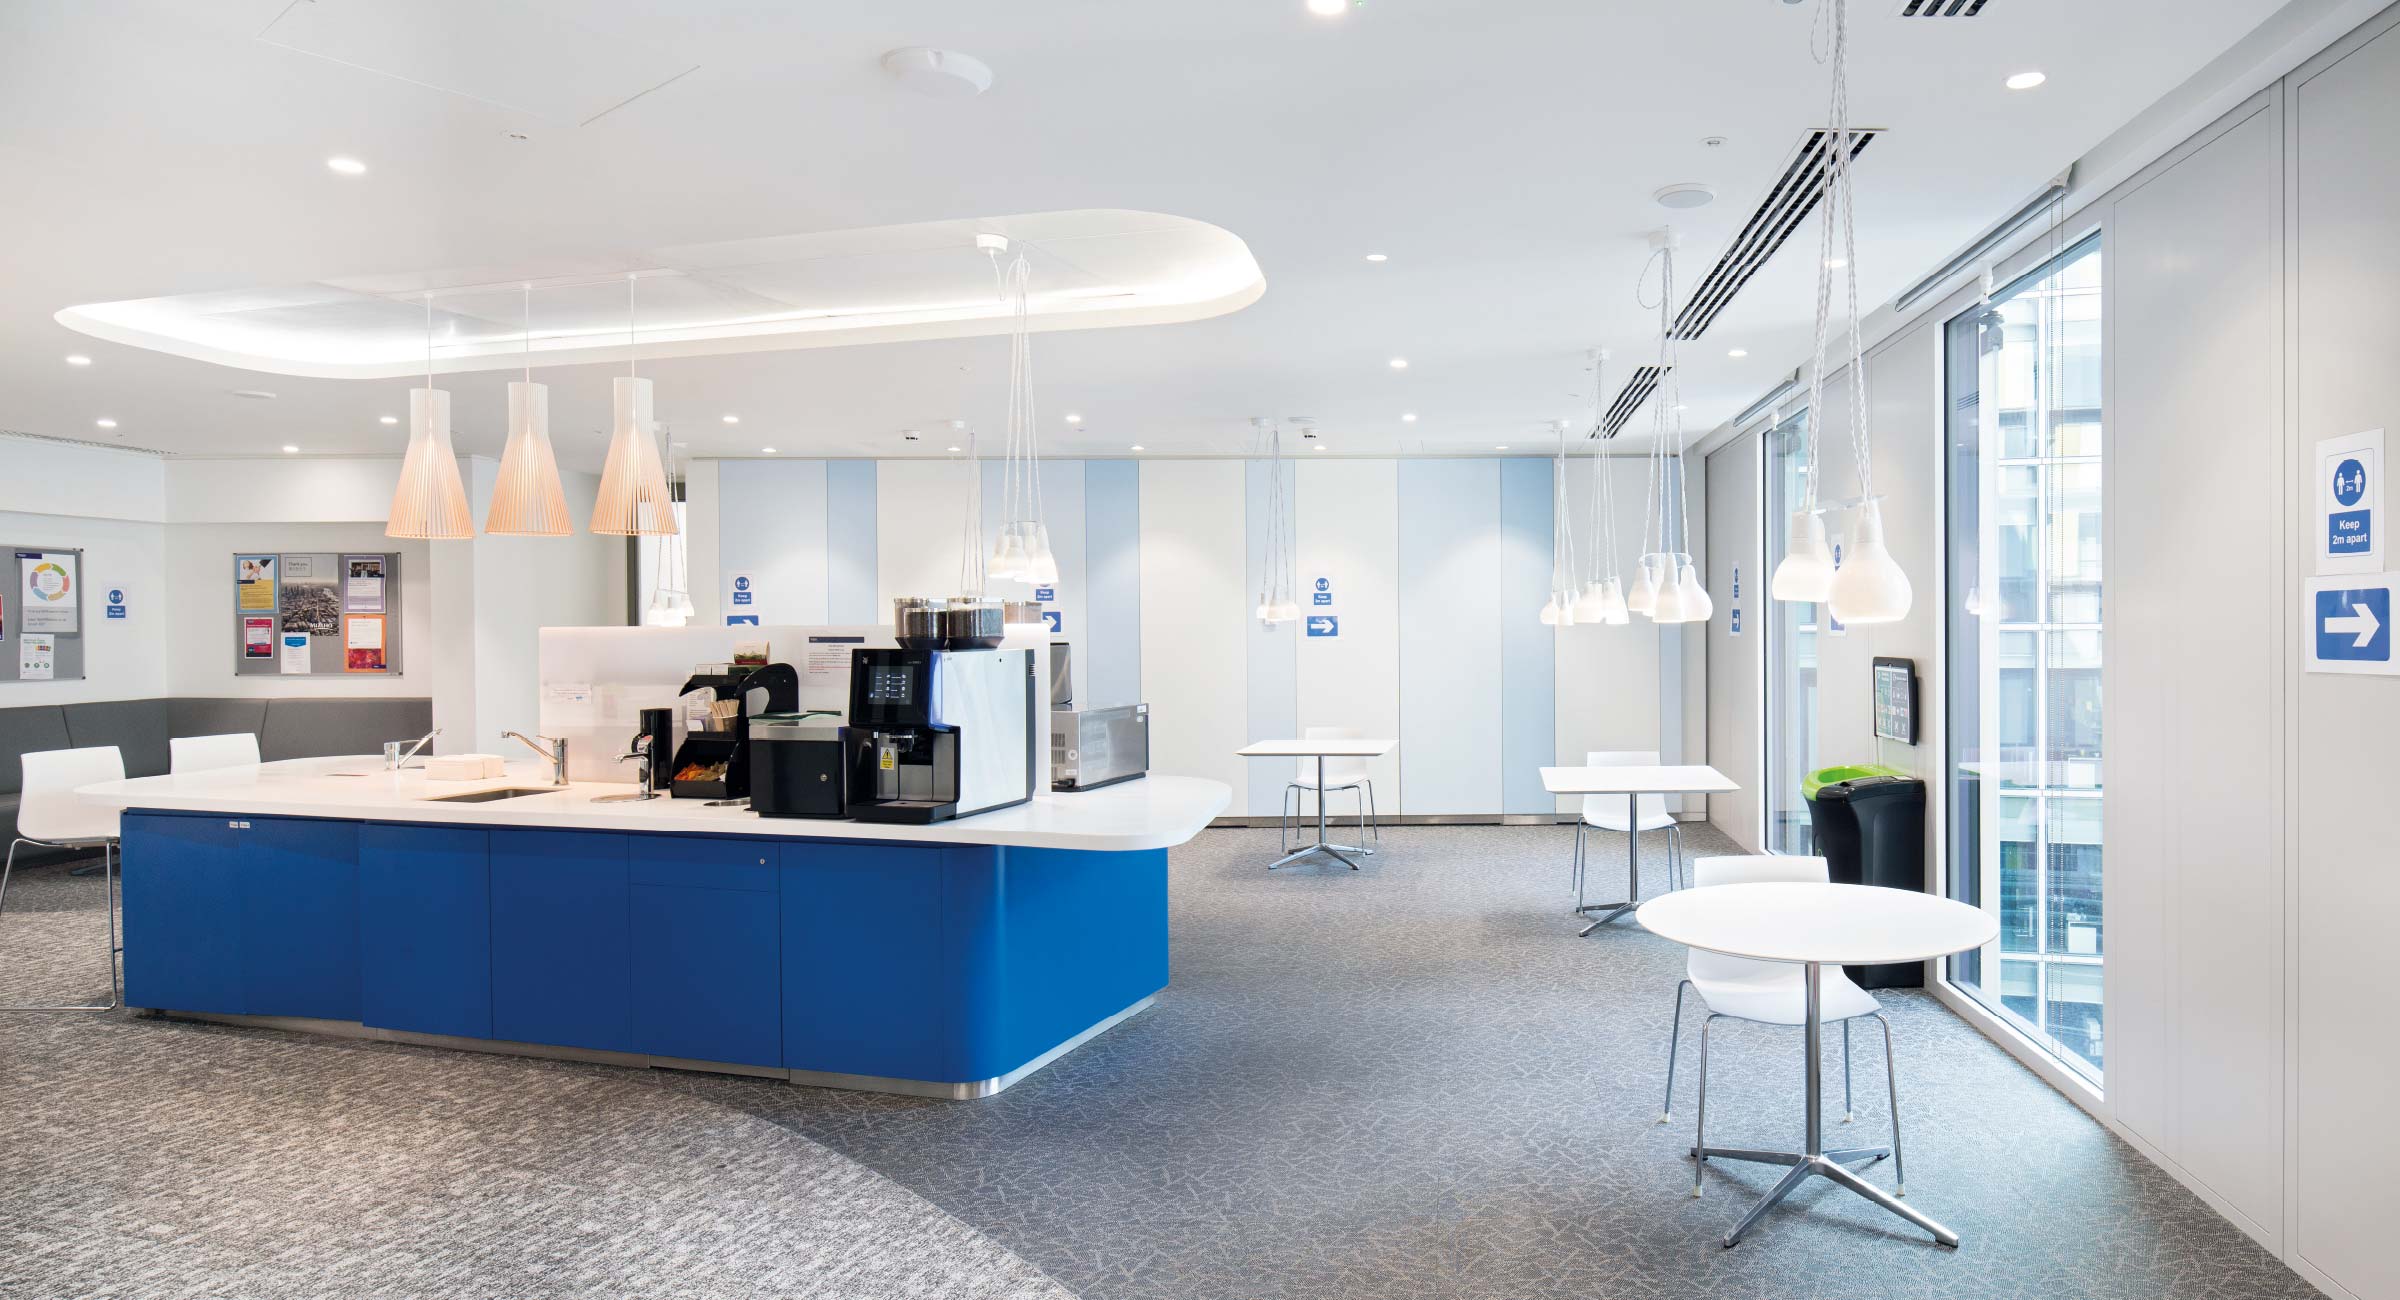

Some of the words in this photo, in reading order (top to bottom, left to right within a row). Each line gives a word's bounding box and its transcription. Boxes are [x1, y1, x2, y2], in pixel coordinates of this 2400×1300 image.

[2339, 519, 2360, 531] Keep
[2332, 535, 2345, 545] 2m
[2346, 533, 2368, 546] apart
